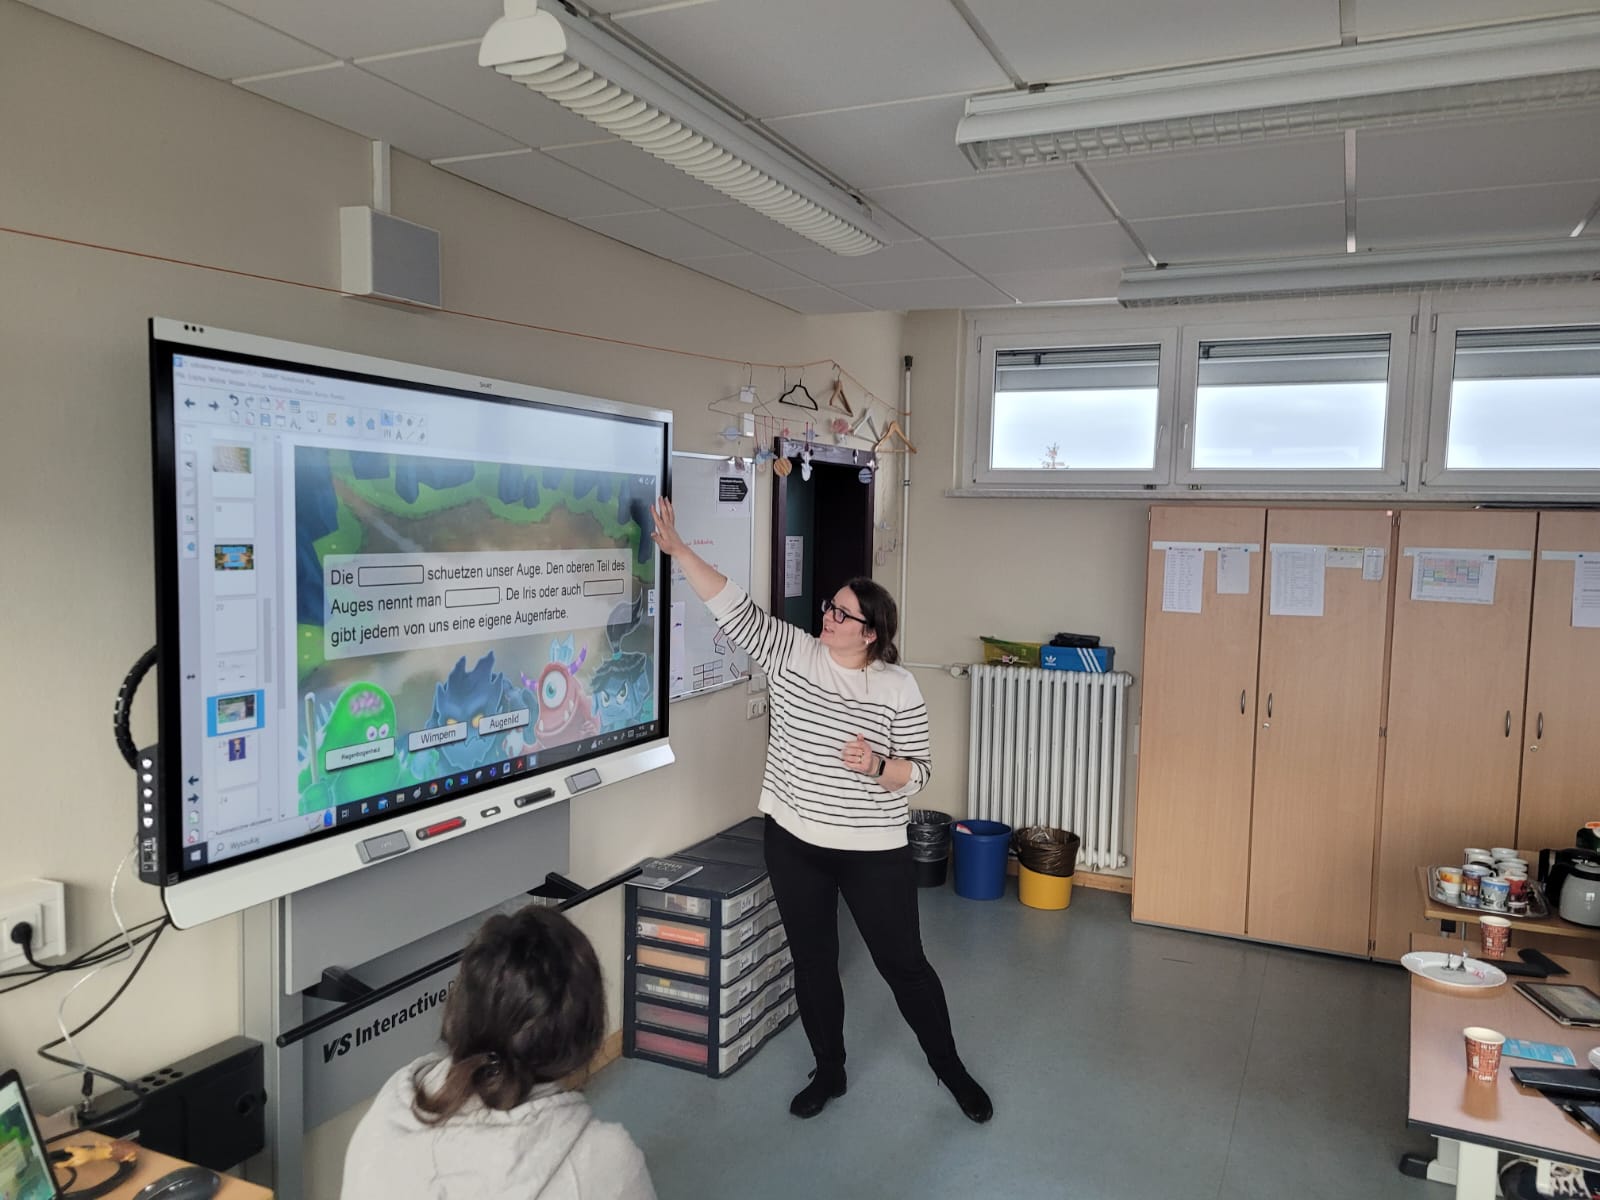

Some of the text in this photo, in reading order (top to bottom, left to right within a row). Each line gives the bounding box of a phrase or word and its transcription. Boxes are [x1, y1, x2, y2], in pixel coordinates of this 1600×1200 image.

[331, 559, 625, 585] Die schuetzen unser Auge. Den oberen Teil des
[330, 583, 582, 617] Auges nennt man De Iris oder auch
[330, 607, 569, 647] gibt jedem von uns eine eigene Augenfarbe.
[489, 713, 520, 730] Augenlid
[420, 728, 457, 745] Wimpern
[322, 1032, 353, 1065] VS
